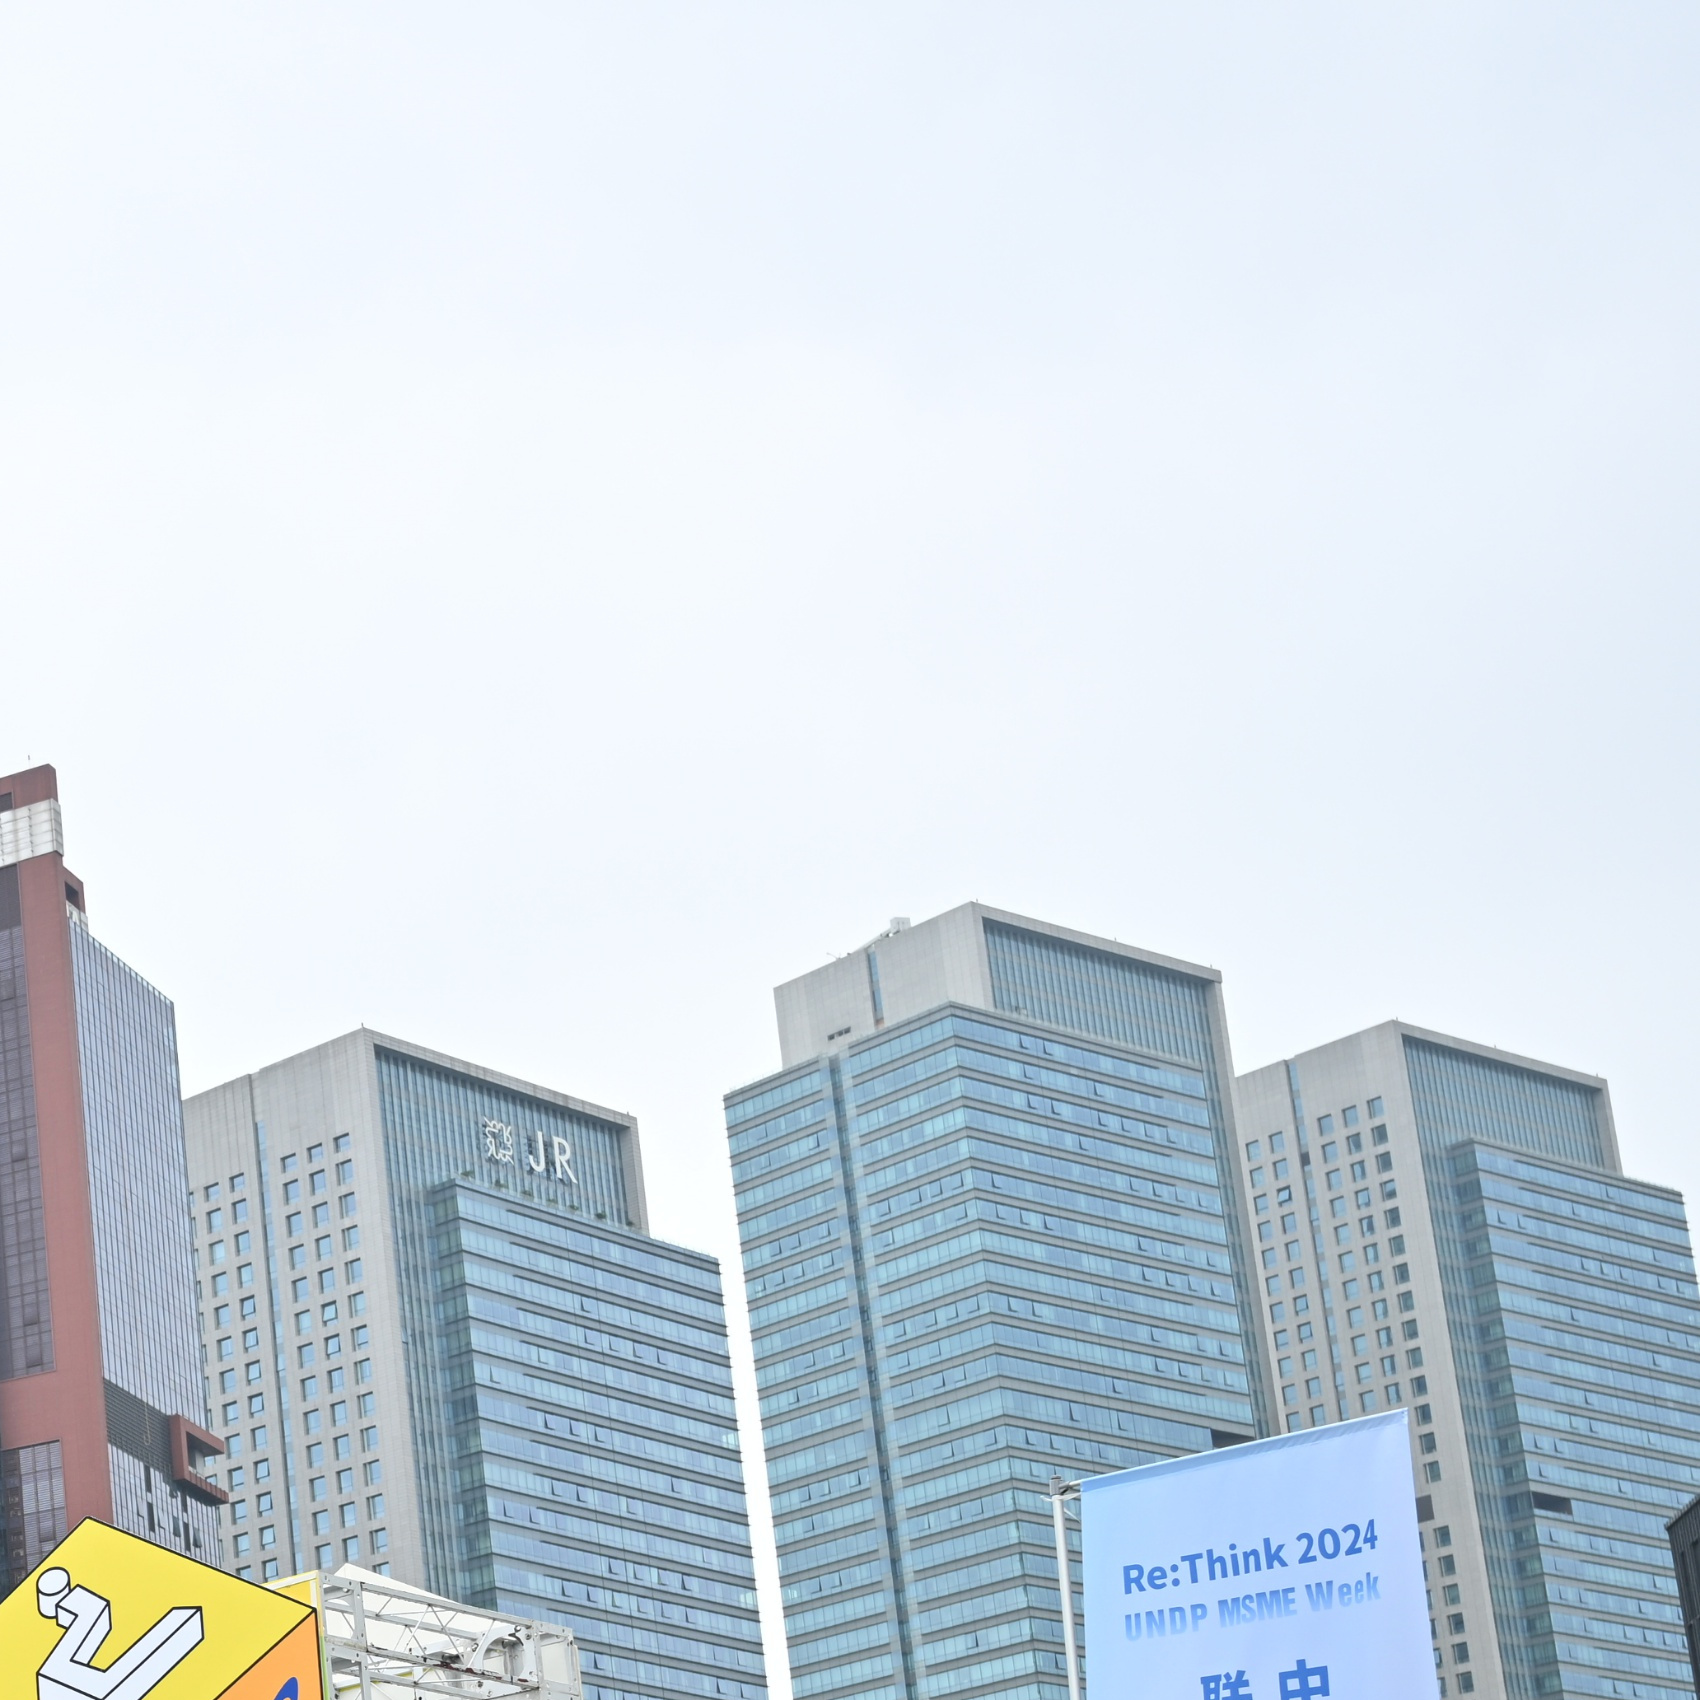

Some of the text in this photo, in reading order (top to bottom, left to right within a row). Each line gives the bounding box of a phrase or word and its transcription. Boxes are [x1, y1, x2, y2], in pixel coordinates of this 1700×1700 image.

[528, 1131, 578, 1184] JR
[1121, 1518, 1378, 1595] Re:Think 2024
[1124, 1572, 1381, 1642] UNDP MSME Week
